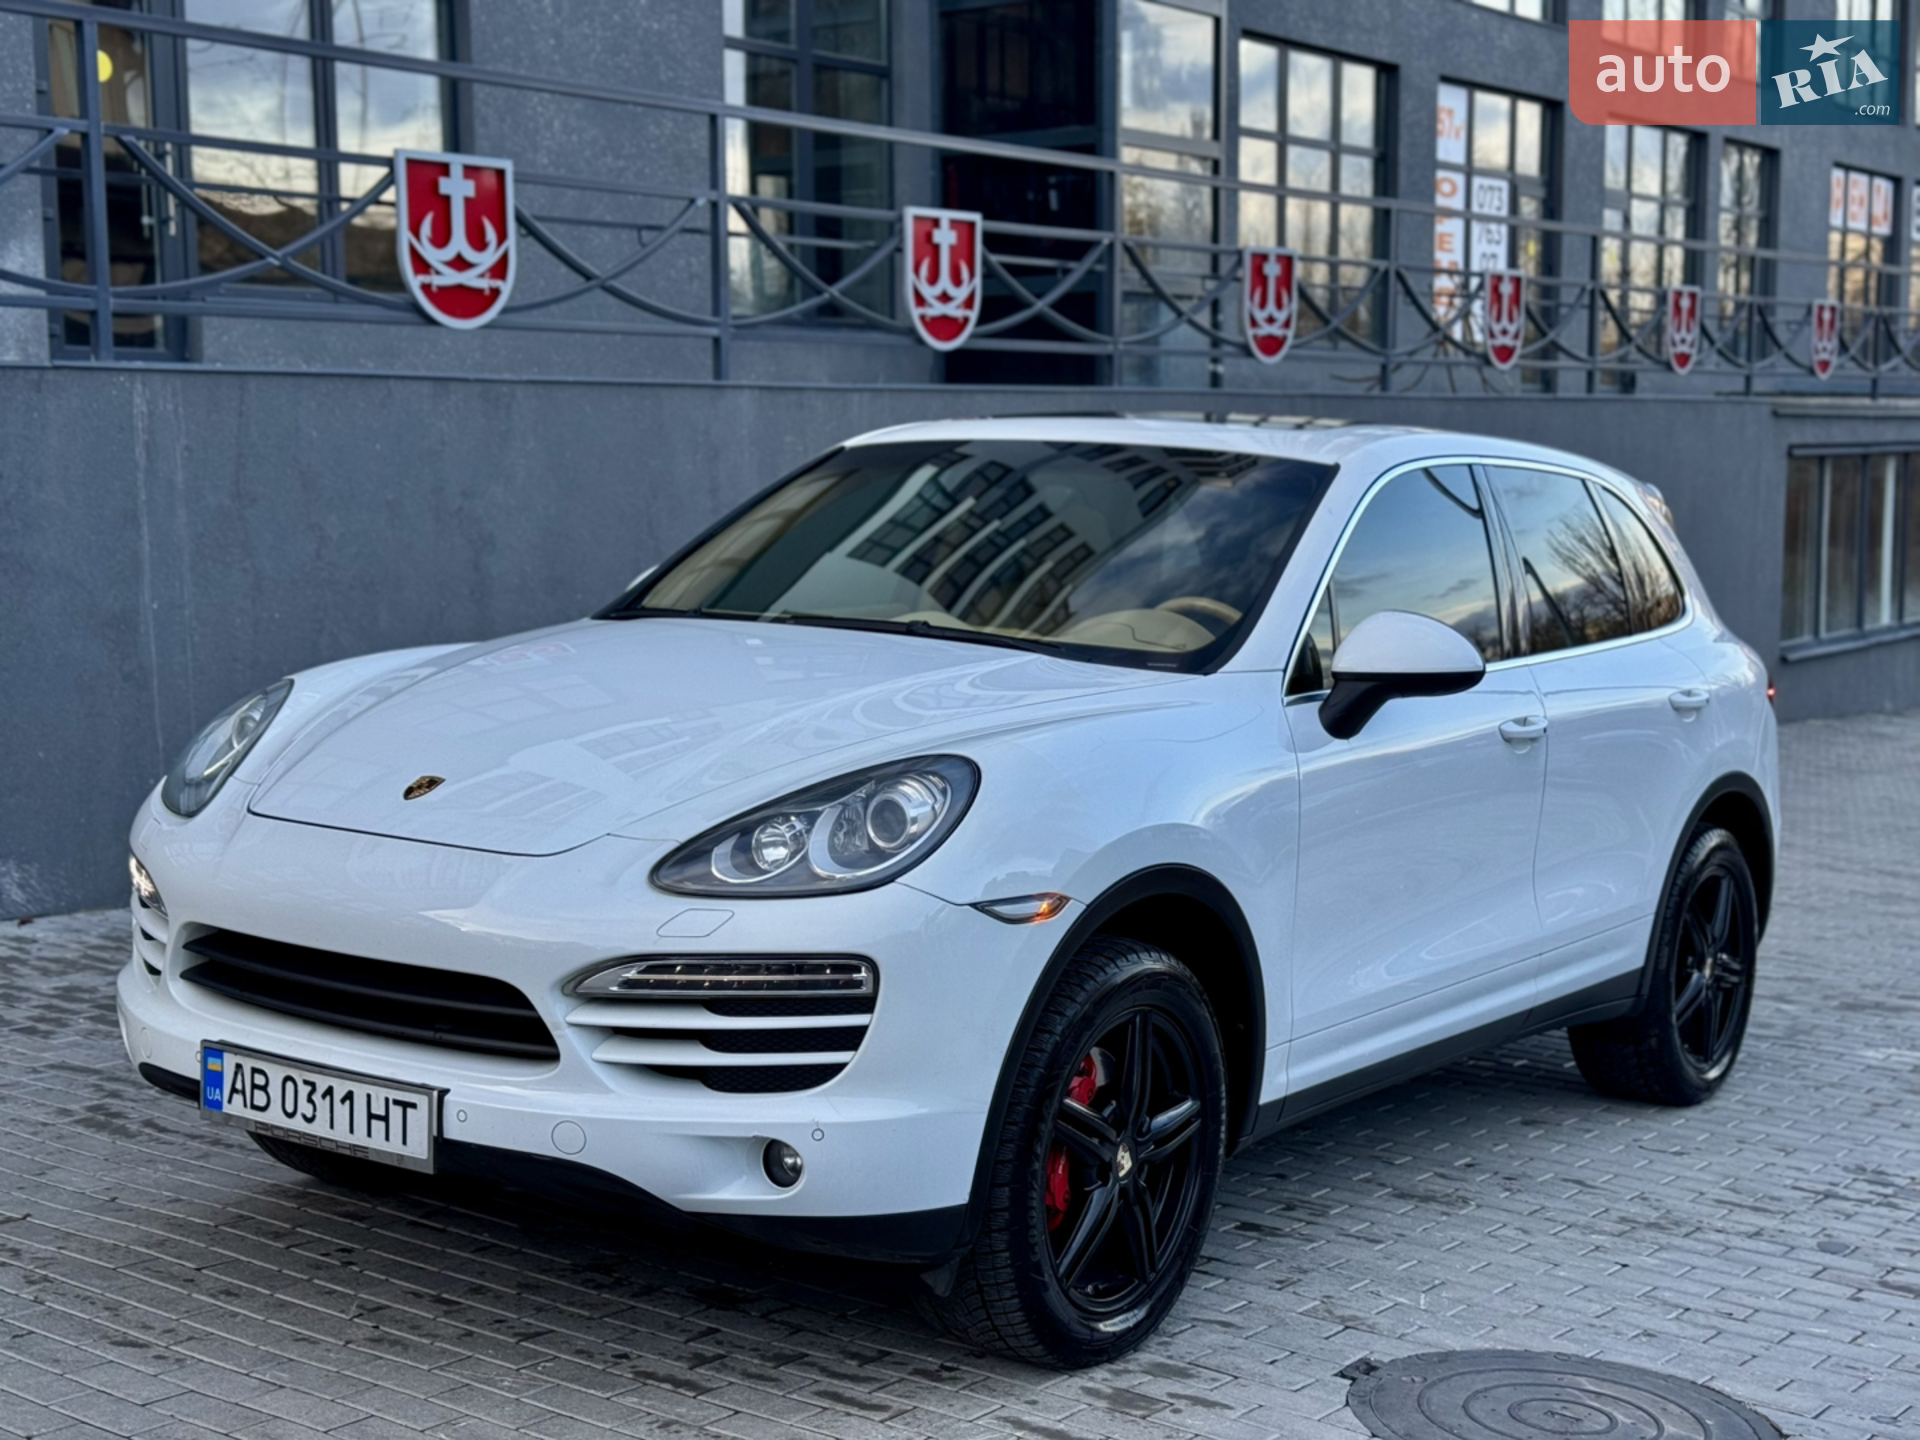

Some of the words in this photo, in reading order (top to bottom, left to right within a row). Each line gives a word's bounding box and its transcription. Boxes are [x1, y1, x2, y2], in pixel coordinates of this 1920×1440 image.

[1476, 184, 1503, 211] 073
[206, 1085, 222, 1102] UA
[227, 1062, 272, 1113] AB
[281, 1074, 354, 1136] 0311
[366, 1092, 418, 1147] HT
[254, 1121, 370, 1159] PORSCHE
